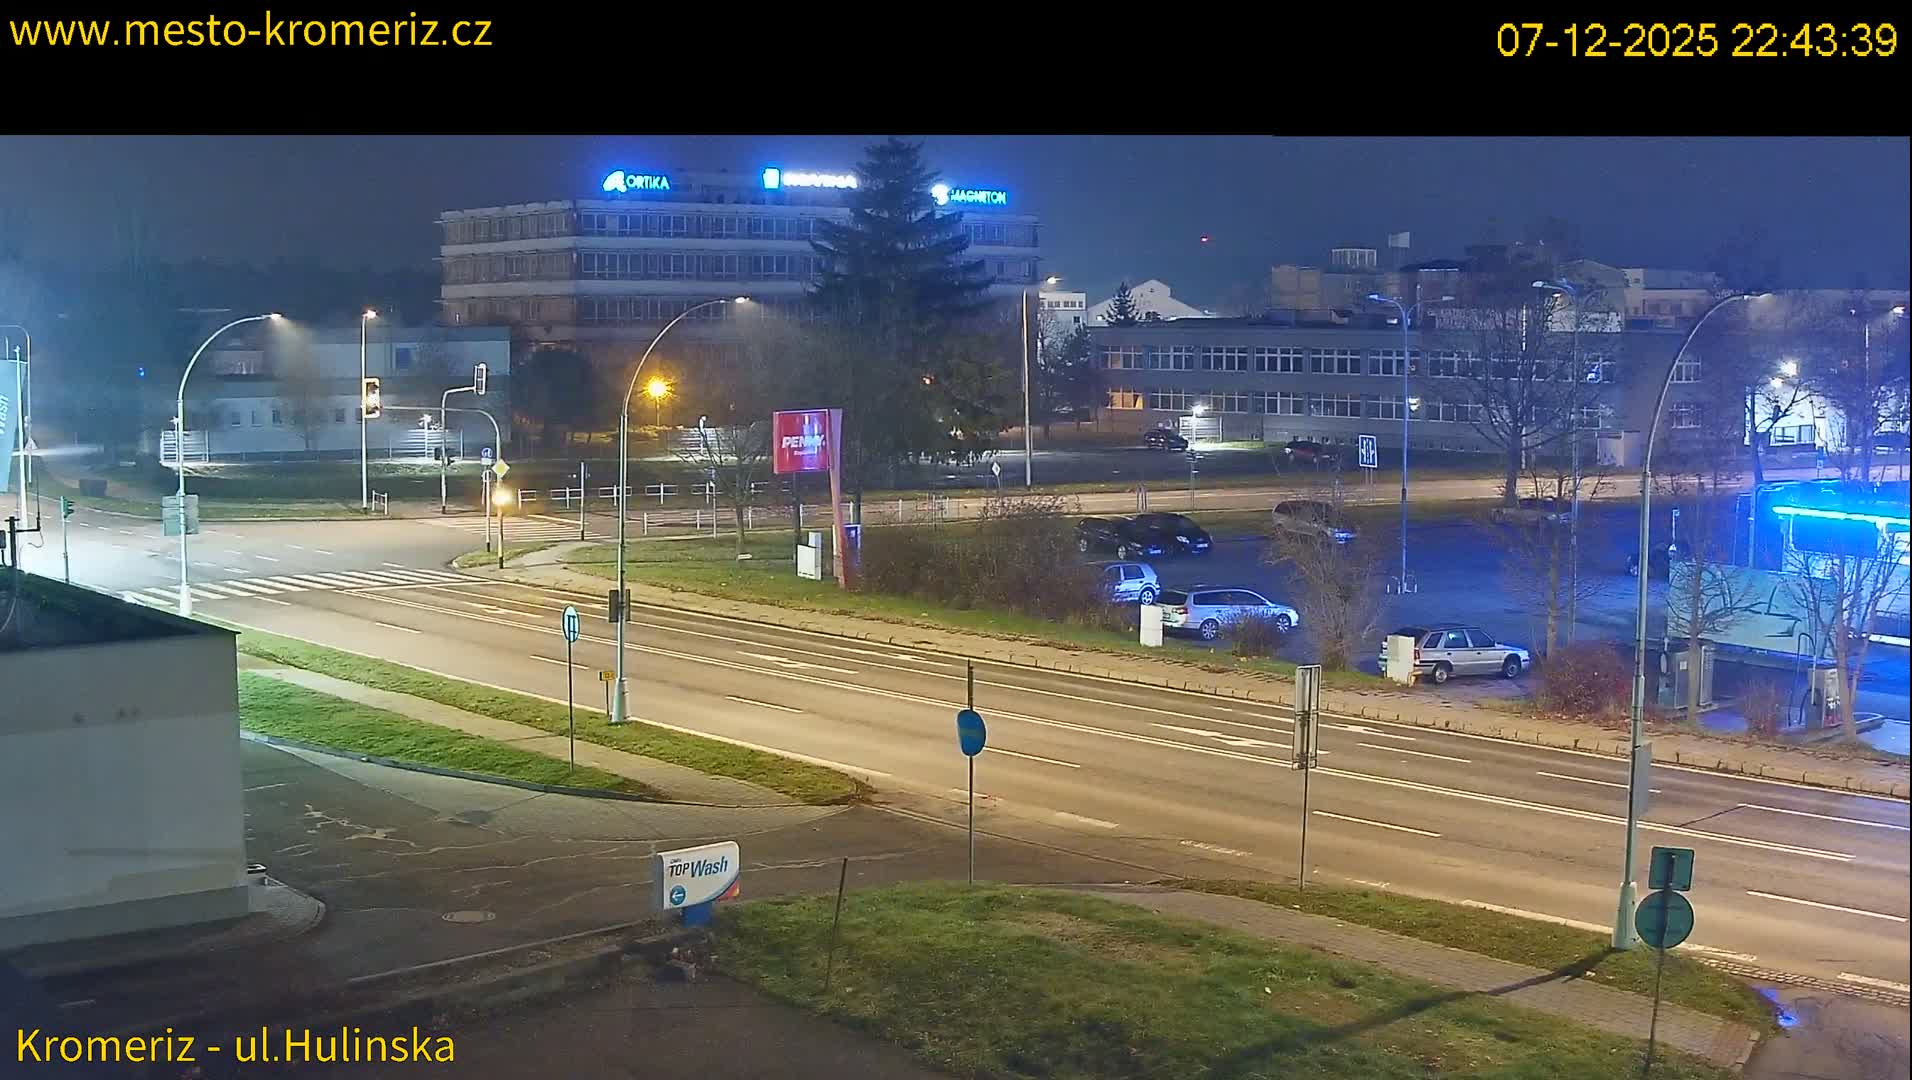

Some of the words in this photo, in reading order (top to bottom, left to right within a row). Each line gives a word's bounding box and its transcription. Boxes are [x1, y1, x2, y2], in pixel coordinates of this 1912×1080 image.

[626, 175, 670, 190] ORTIKA
[669, 862, 690, 877] TOP
[691, 856, 728, 878] Wash
